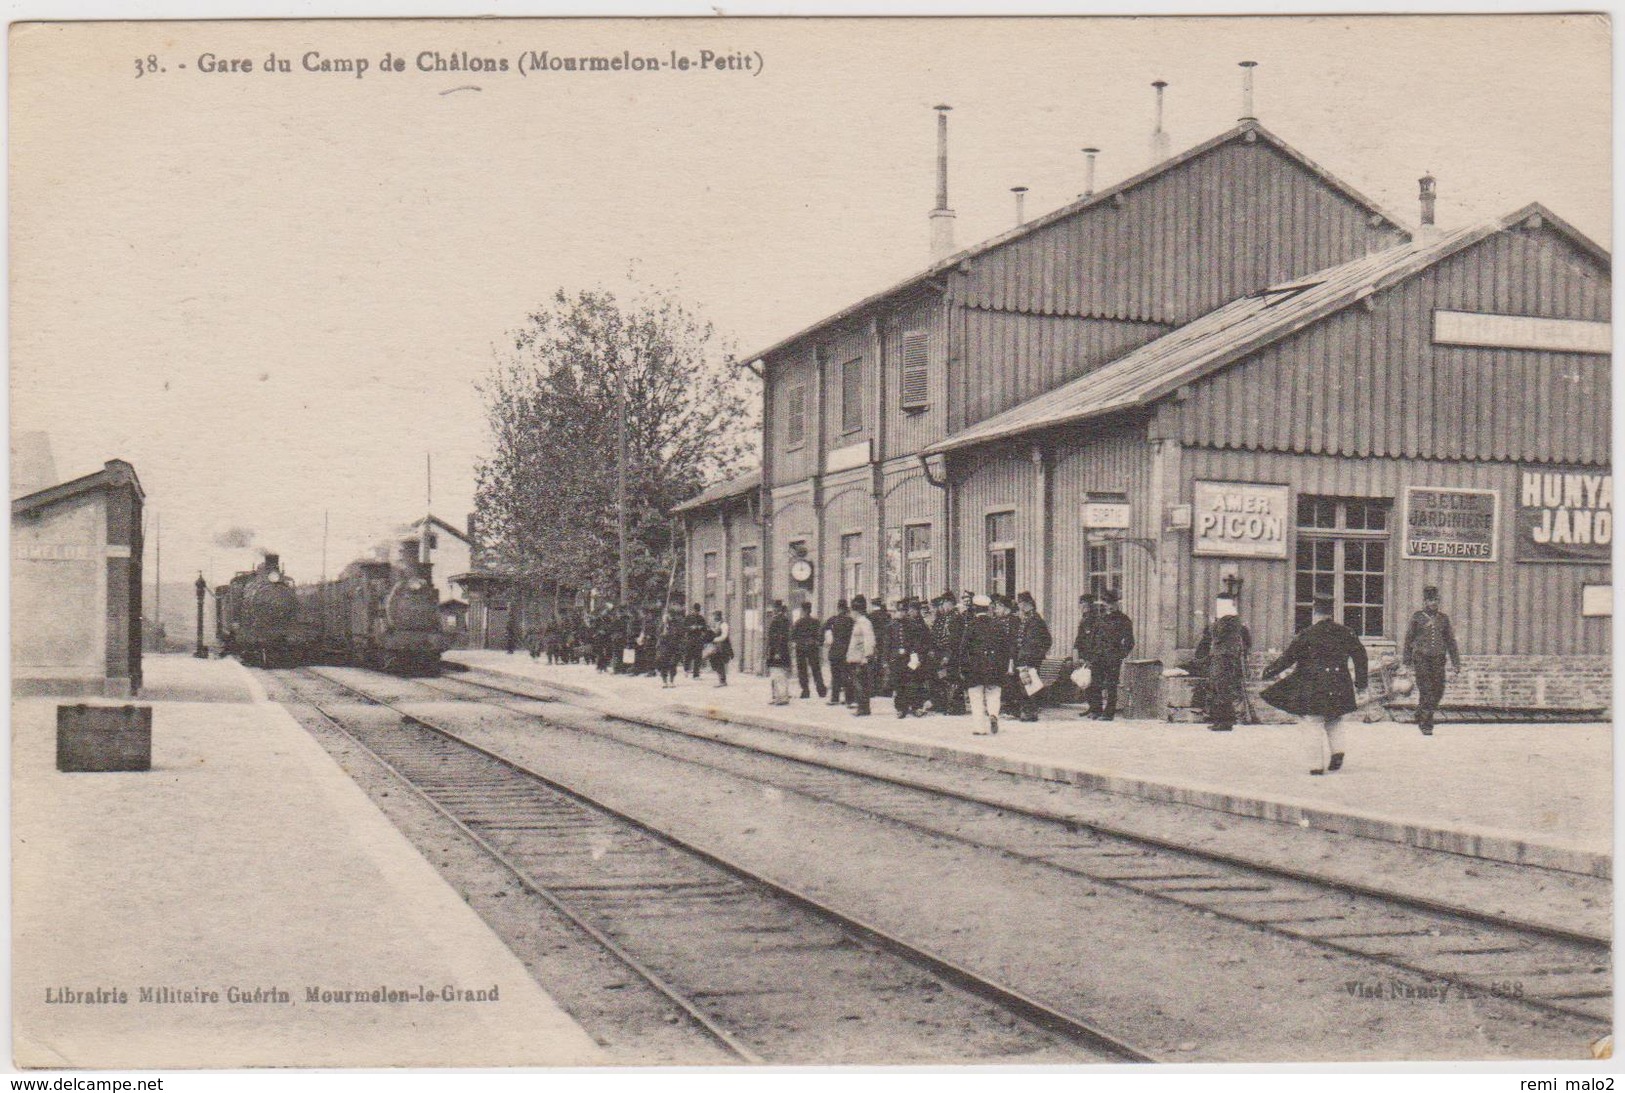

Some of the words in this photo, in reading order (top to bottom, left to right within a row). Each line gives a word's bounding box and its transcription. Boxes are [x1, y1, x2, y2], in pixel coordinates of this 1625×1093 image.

[1522, 473, 1612, 508] HUNYA
[1212, 494, 1270, 515] AMER
[1201, 514, 1282, 541] PICON
